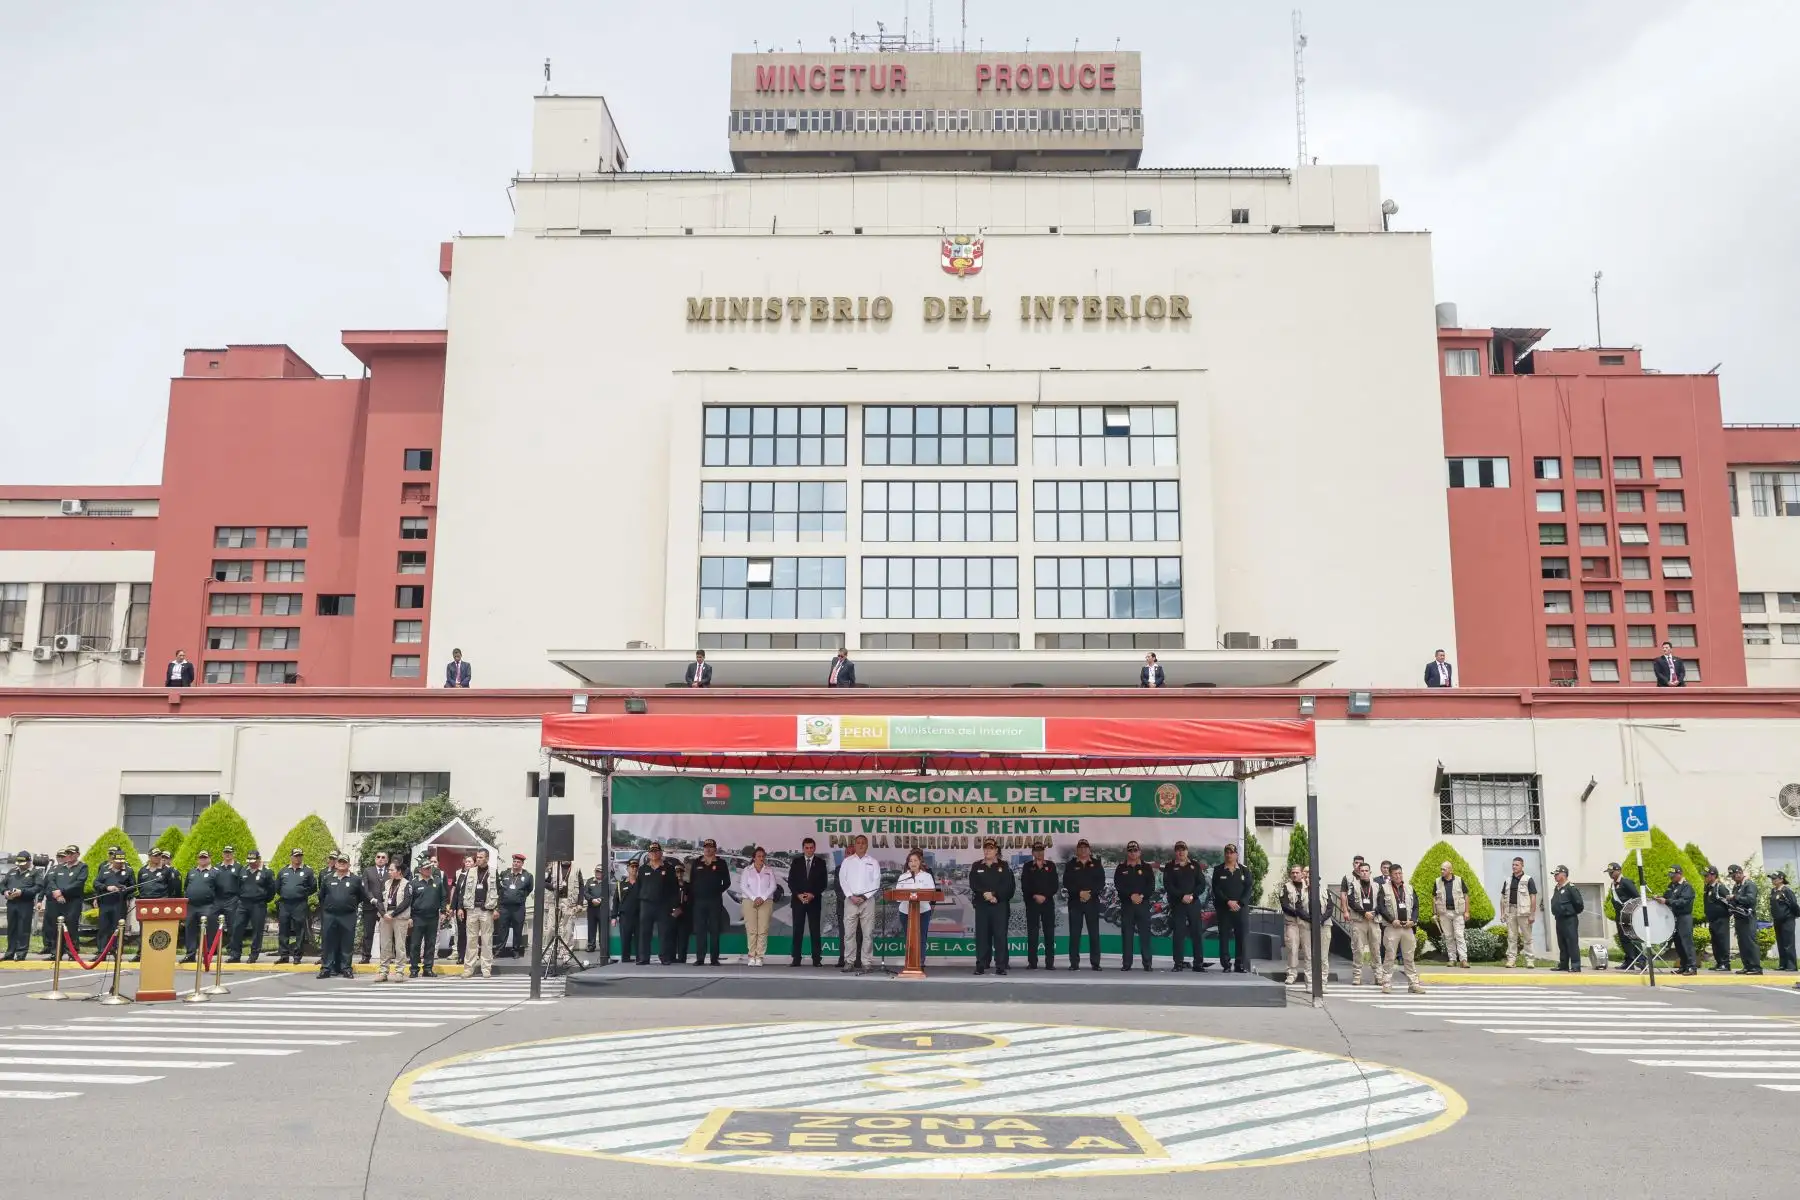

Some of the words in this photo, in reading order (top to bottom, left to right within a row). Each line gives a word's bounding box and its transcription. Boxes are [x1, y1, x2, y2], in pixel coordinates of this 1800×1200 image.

[756, 64, 907, 93] MINCETUR
[976, 63, 1116, 92] PRODUCE
[686, 296, 893, 322] MINISTERIO
[923, 296, 992, 322] DEL
[1020, 295, 1192, 321] INTERIOR
[895, 725, 956, 735] Ministerio
[958, 725, 976, 736] del
[979, 726, 1022, 736] Interior
[753, 782, 855, 801] POLICÍA
[865, 786, 998, 803] NACIONAL
[1006, 787, 1056, 802] DEL
[1063, 784, 1132, 802] PERÚ
[858, 804, 914, 814] REGIÓN
[923, 805, 994, 814] POLICIAL
[1002, 805, 1038, 814] LIMA
[815, 818, 853, 833] 150
[860, 818, 978, 834] VEHICULOS
[986, 819, 1080, 834] RENTING
[872, 835, 889, 848] LA
[944, 942, 962, 951] LA
[901, 1036, 935, 1047] 1
[792, 1115, 1042, 1131] ZONA
[717, 1131, 1129, 1151] SEGURA
